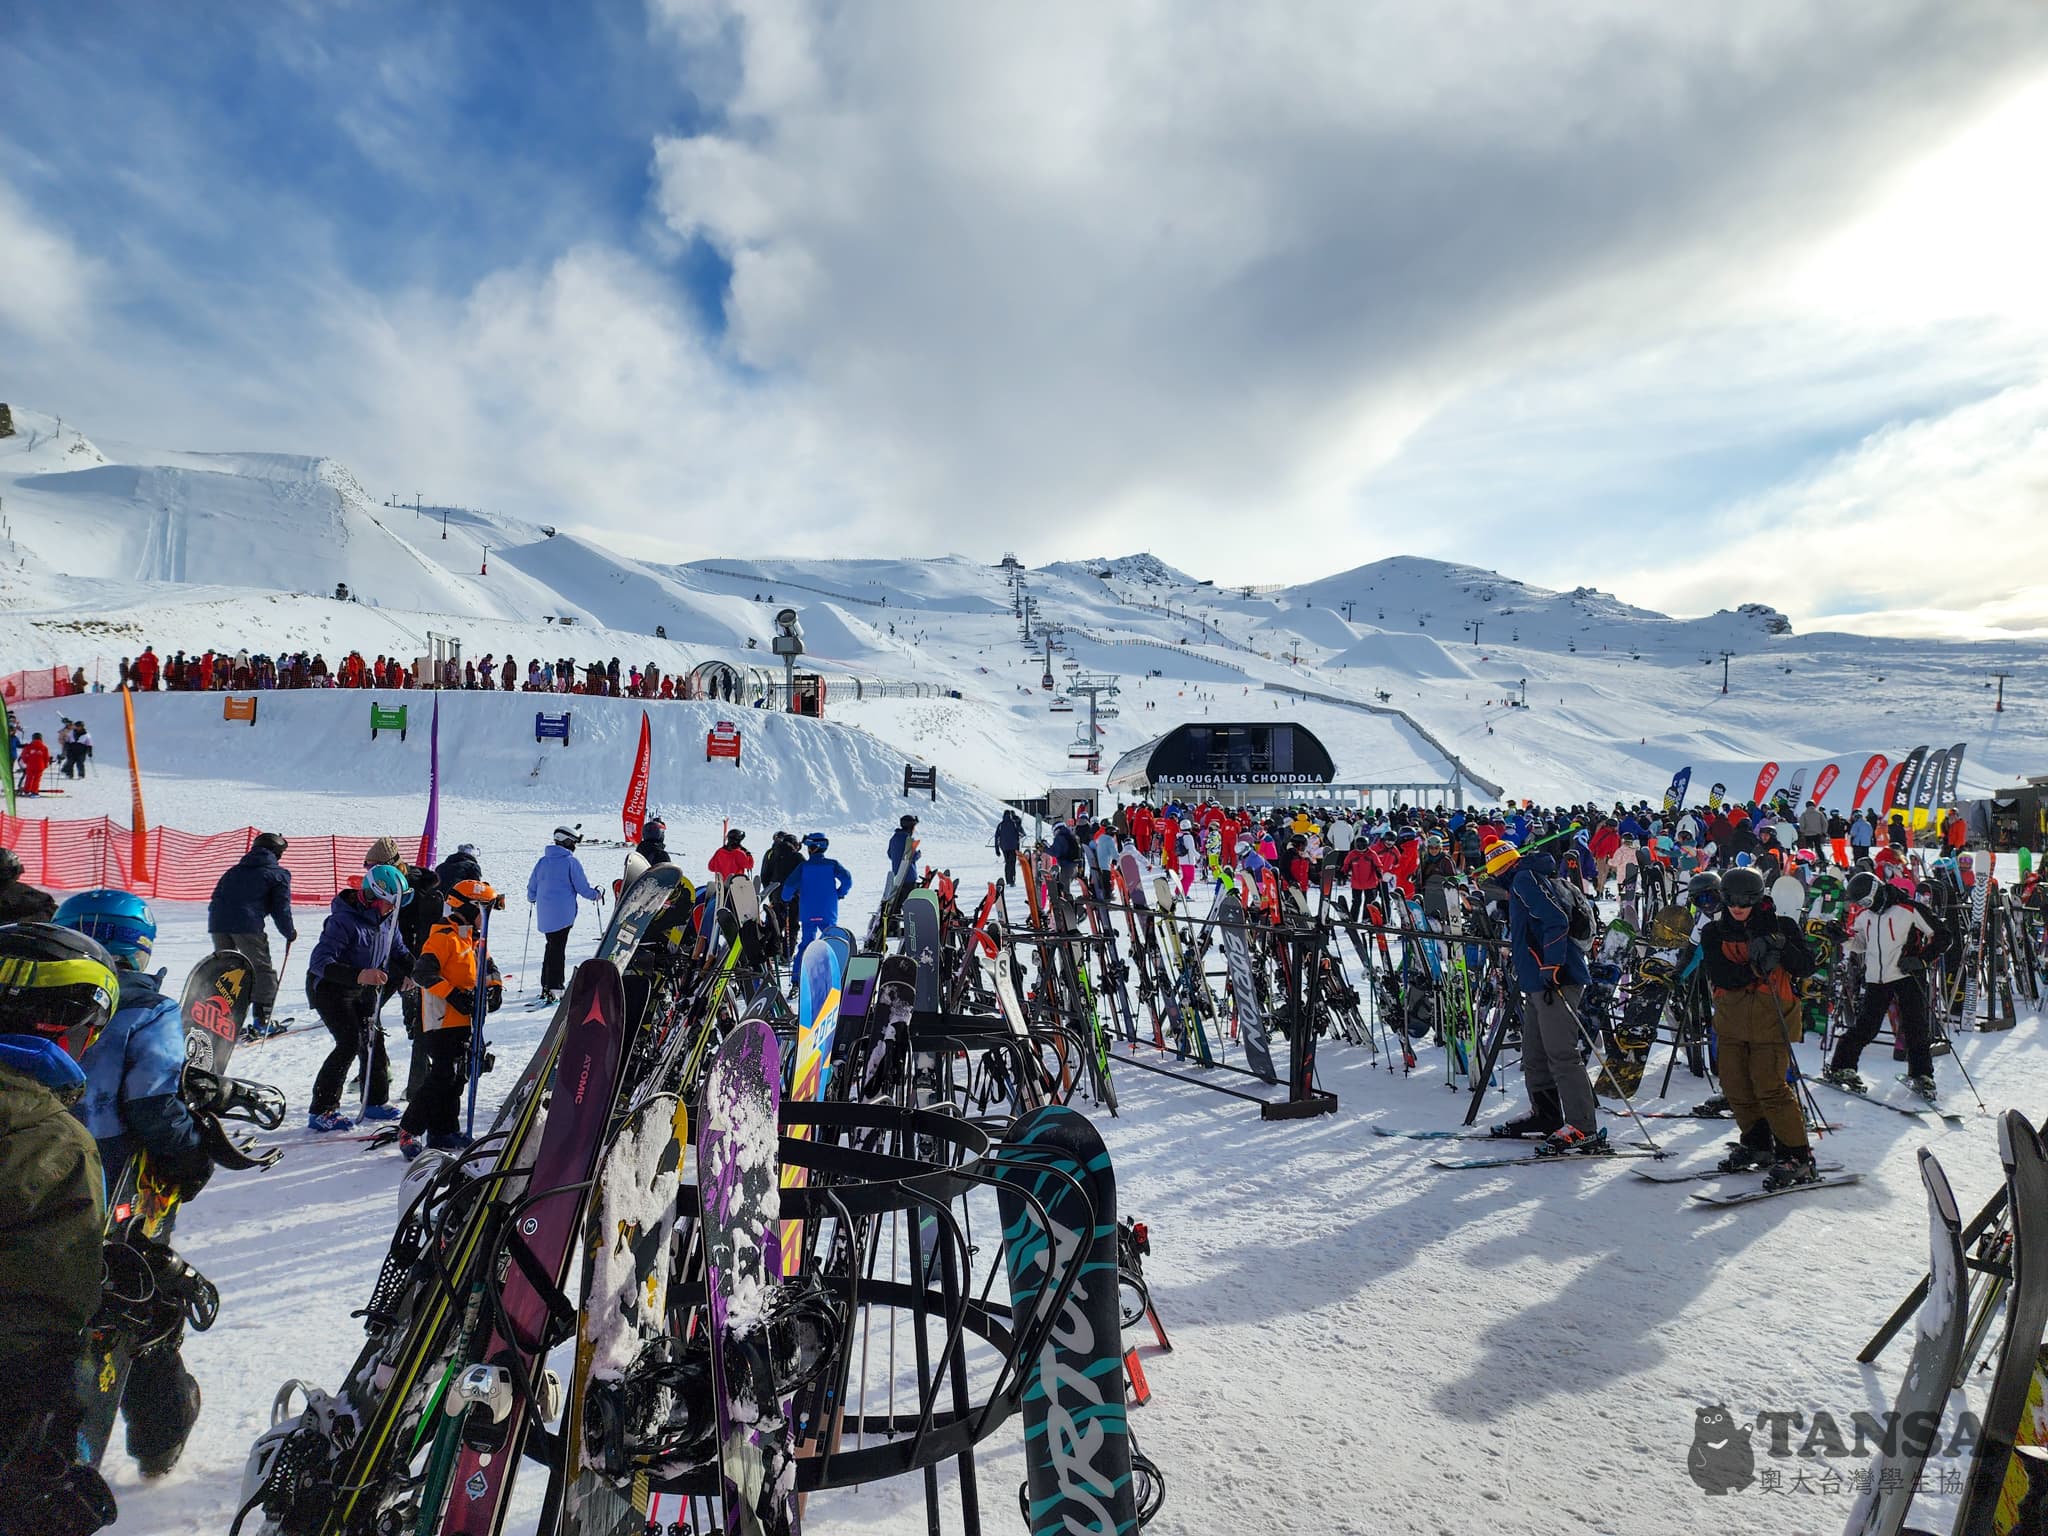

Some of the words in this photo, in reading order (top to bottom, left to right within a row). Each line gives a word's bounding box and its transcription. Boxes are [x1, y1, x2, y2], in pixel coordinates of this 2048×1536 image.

[627, 780, 645, 814] Private
[1158, 774, 1247, 783] McDOUGALL'S
[1252, 773, 1323, 783] CHONDOLA
[1228, 932, 1266, 1053] BURTON
[191, 999, 236, 1041] alta
[573, 1053, 592, 1105] ATOMIC
